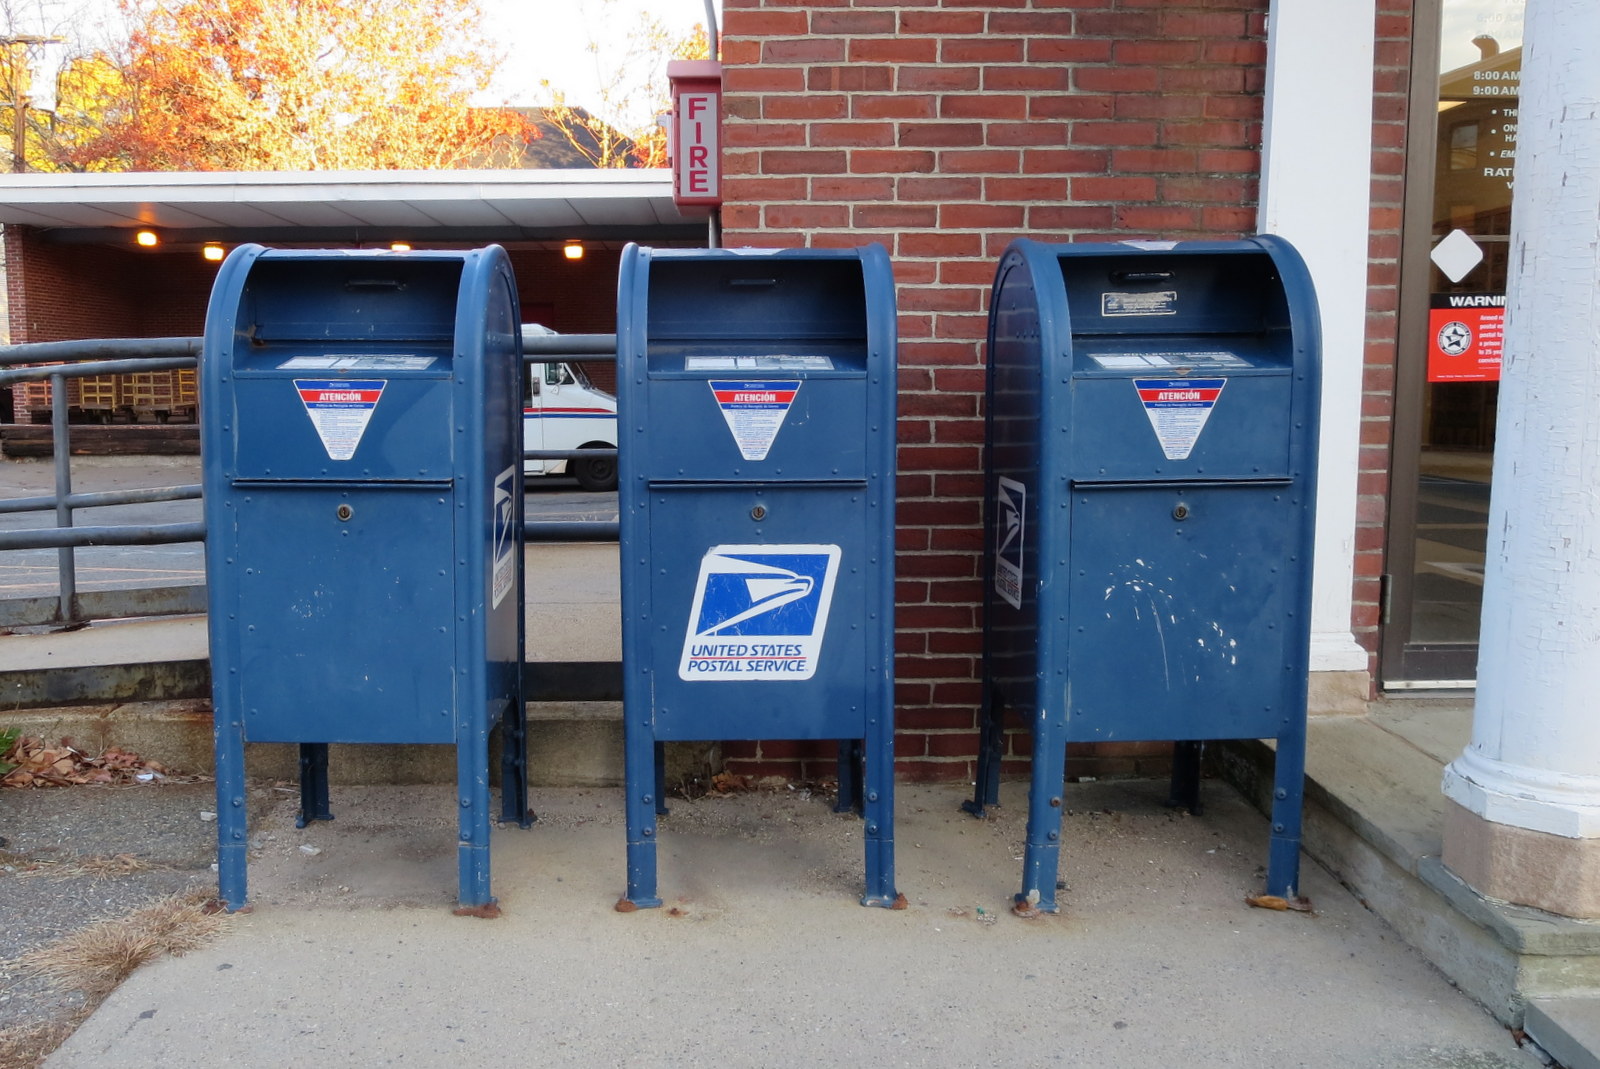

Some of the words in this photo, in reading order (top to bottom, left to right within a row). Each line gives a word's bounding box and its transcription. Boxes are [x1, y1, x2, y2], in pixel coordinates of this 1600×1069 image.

[1474, 71, 1500, 80] 8:00
[1501, 71, 1520, 80] AM
[1473, 86, 1499, 95] 9:00
[688, 97, 708, 192] FIRE
[1484, 168, 1514, 176] RAT
[319, 392, 361, 401] ATENCIÓN
[734, 392, 776, 402] ATENCIÓN
[1158, 390, 1200, 400] ATENCIÓN
[691, 644, 748, 656] UNITED
[750, 644, 802, 656] STATES
[688, 660, 743, 672] POSTAL
[746, 660, 806, 672] SERVICE
